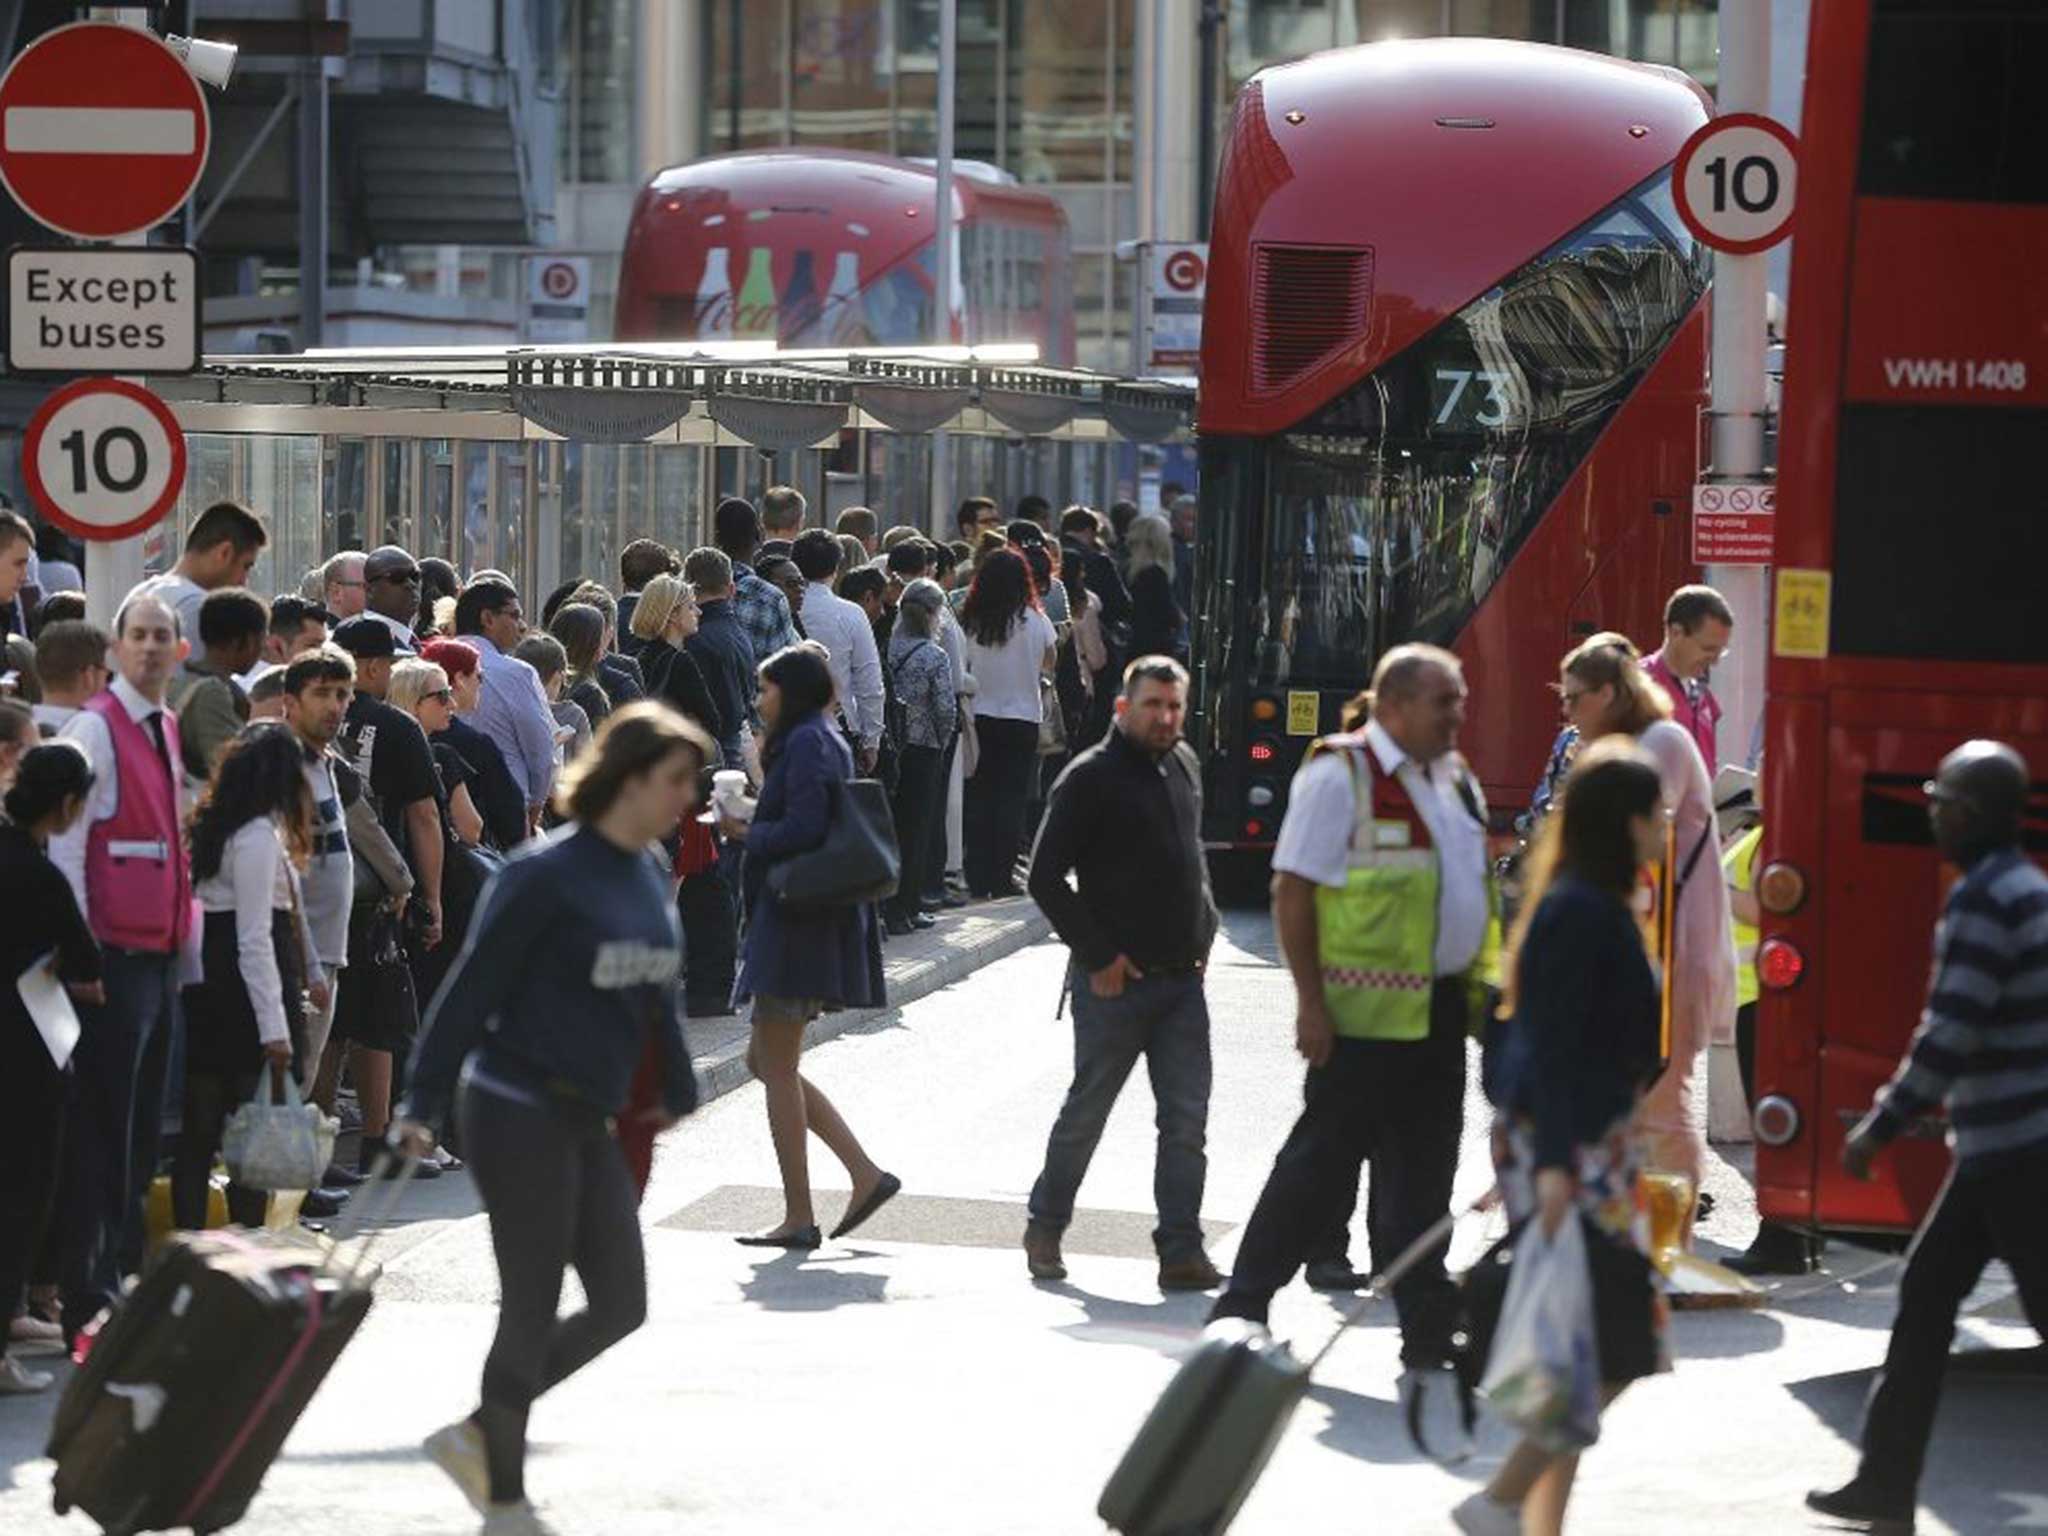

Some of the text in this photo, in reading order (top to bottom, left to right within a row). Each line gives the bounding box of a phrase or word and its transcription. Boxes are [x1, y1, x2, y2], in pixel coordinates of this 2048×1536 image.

[1705, 155, 1779, 214] 10
[27, 268, 177, 310] Except
[40, 315, 166, 349] buses
[1436, 369, 1511, 426] 73
[1884, 357, 2027, 391] VWH 1408
[60, 426, 149, 494] 10
